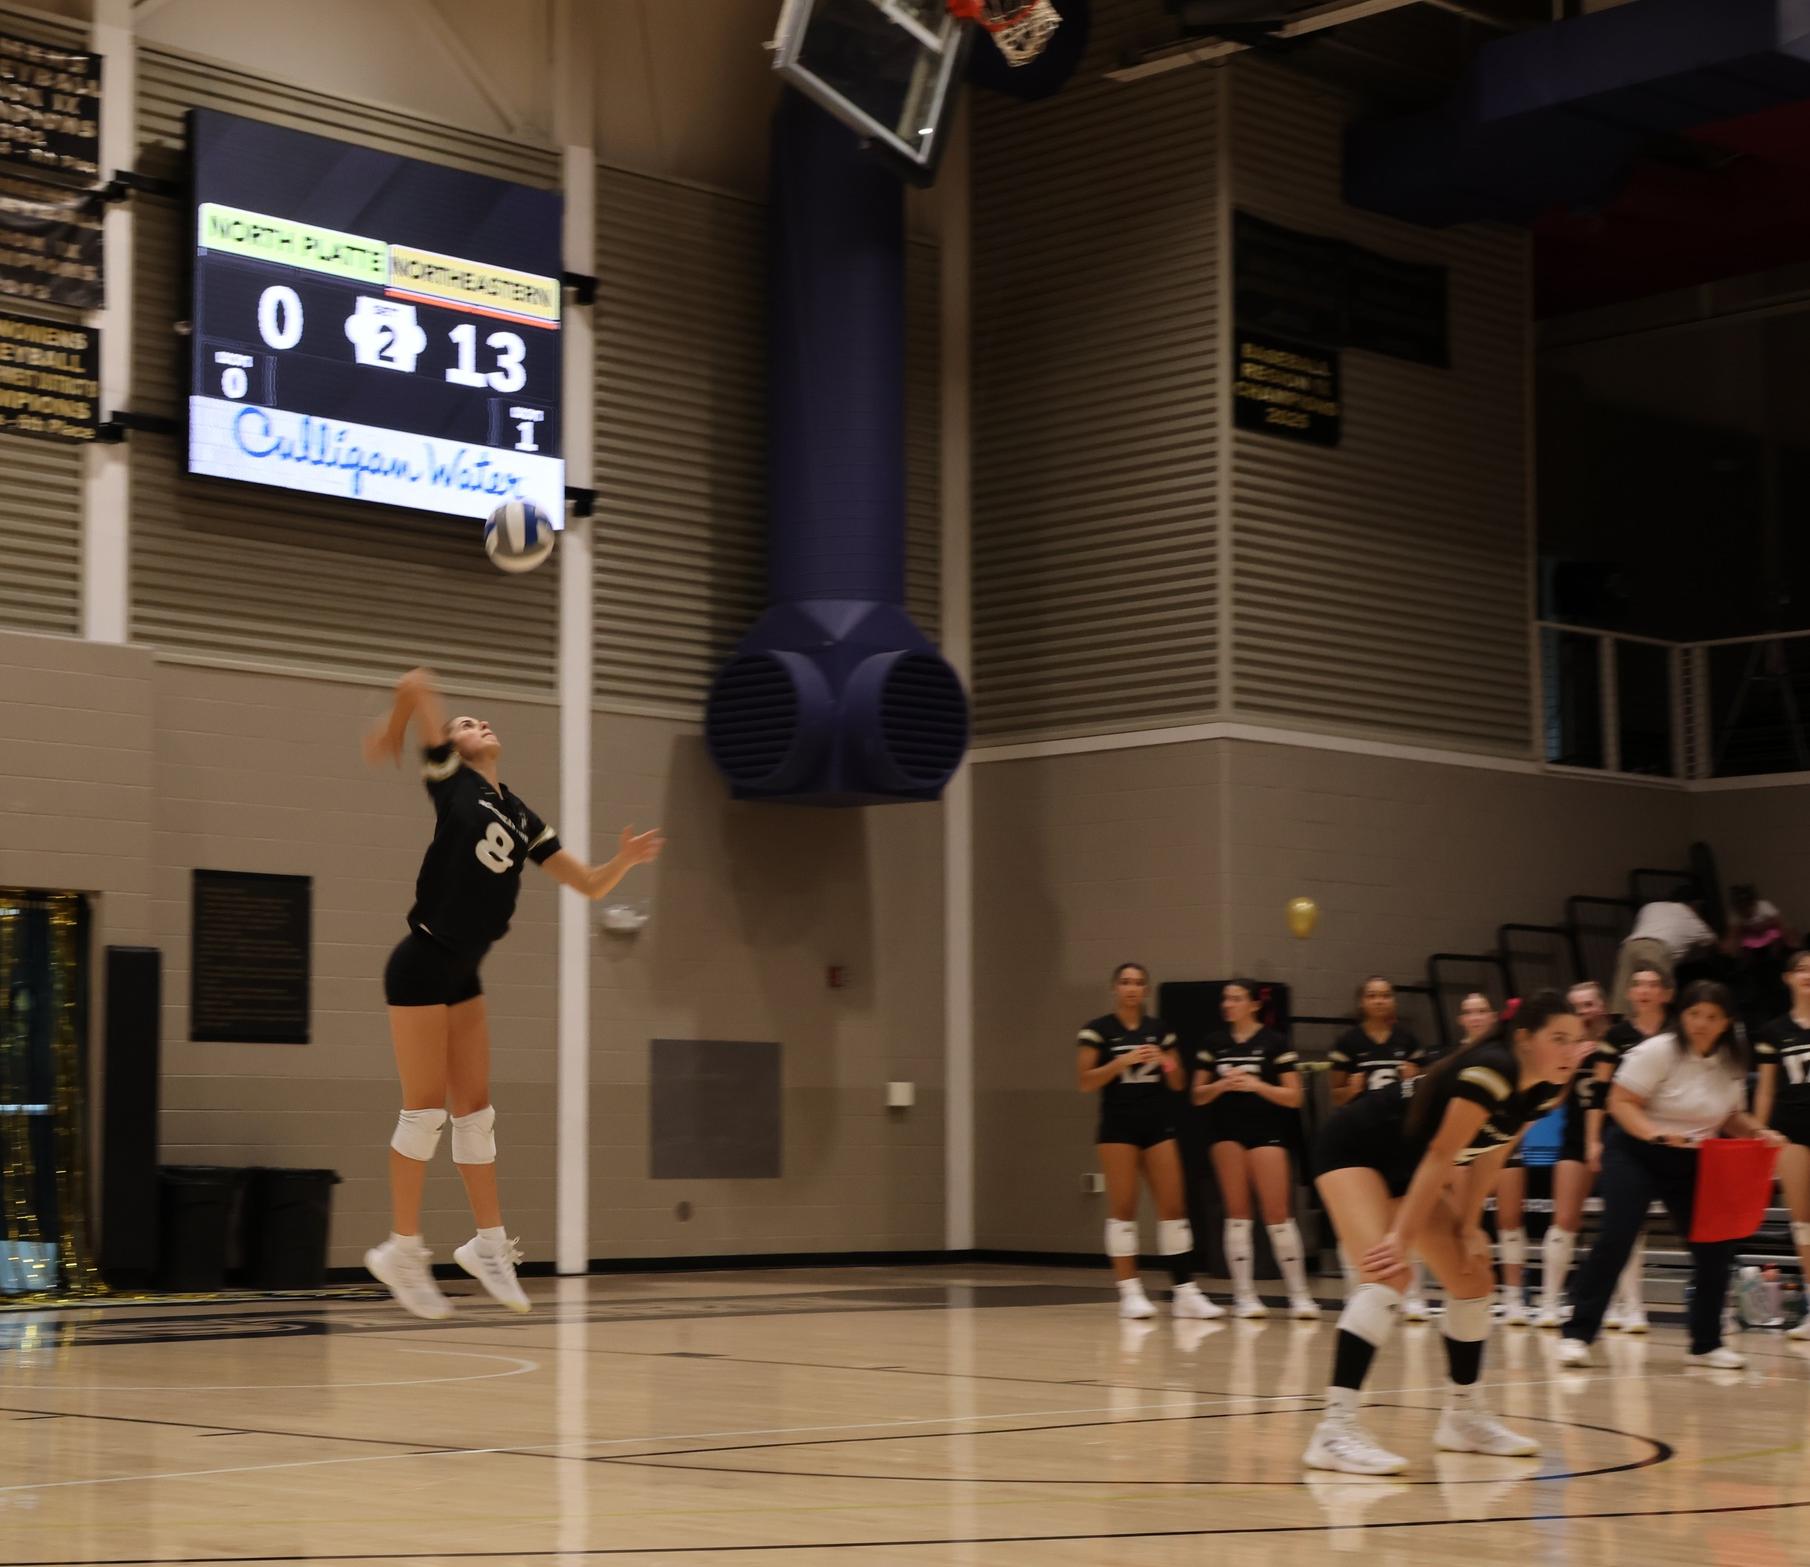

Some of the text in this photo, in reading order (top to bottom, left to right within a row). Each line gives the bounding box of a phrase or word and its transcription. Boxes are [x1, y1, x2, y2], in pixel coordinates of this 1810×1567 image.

[258, 285, 304, 350] 0
[374, 323, 397, 364] 2
[221, 367, 248, 399] 0
[445, 323, 527, 393] 13
[233, 406, 524, 497] Culligan Water
[514, 421, 539, 452] 1
